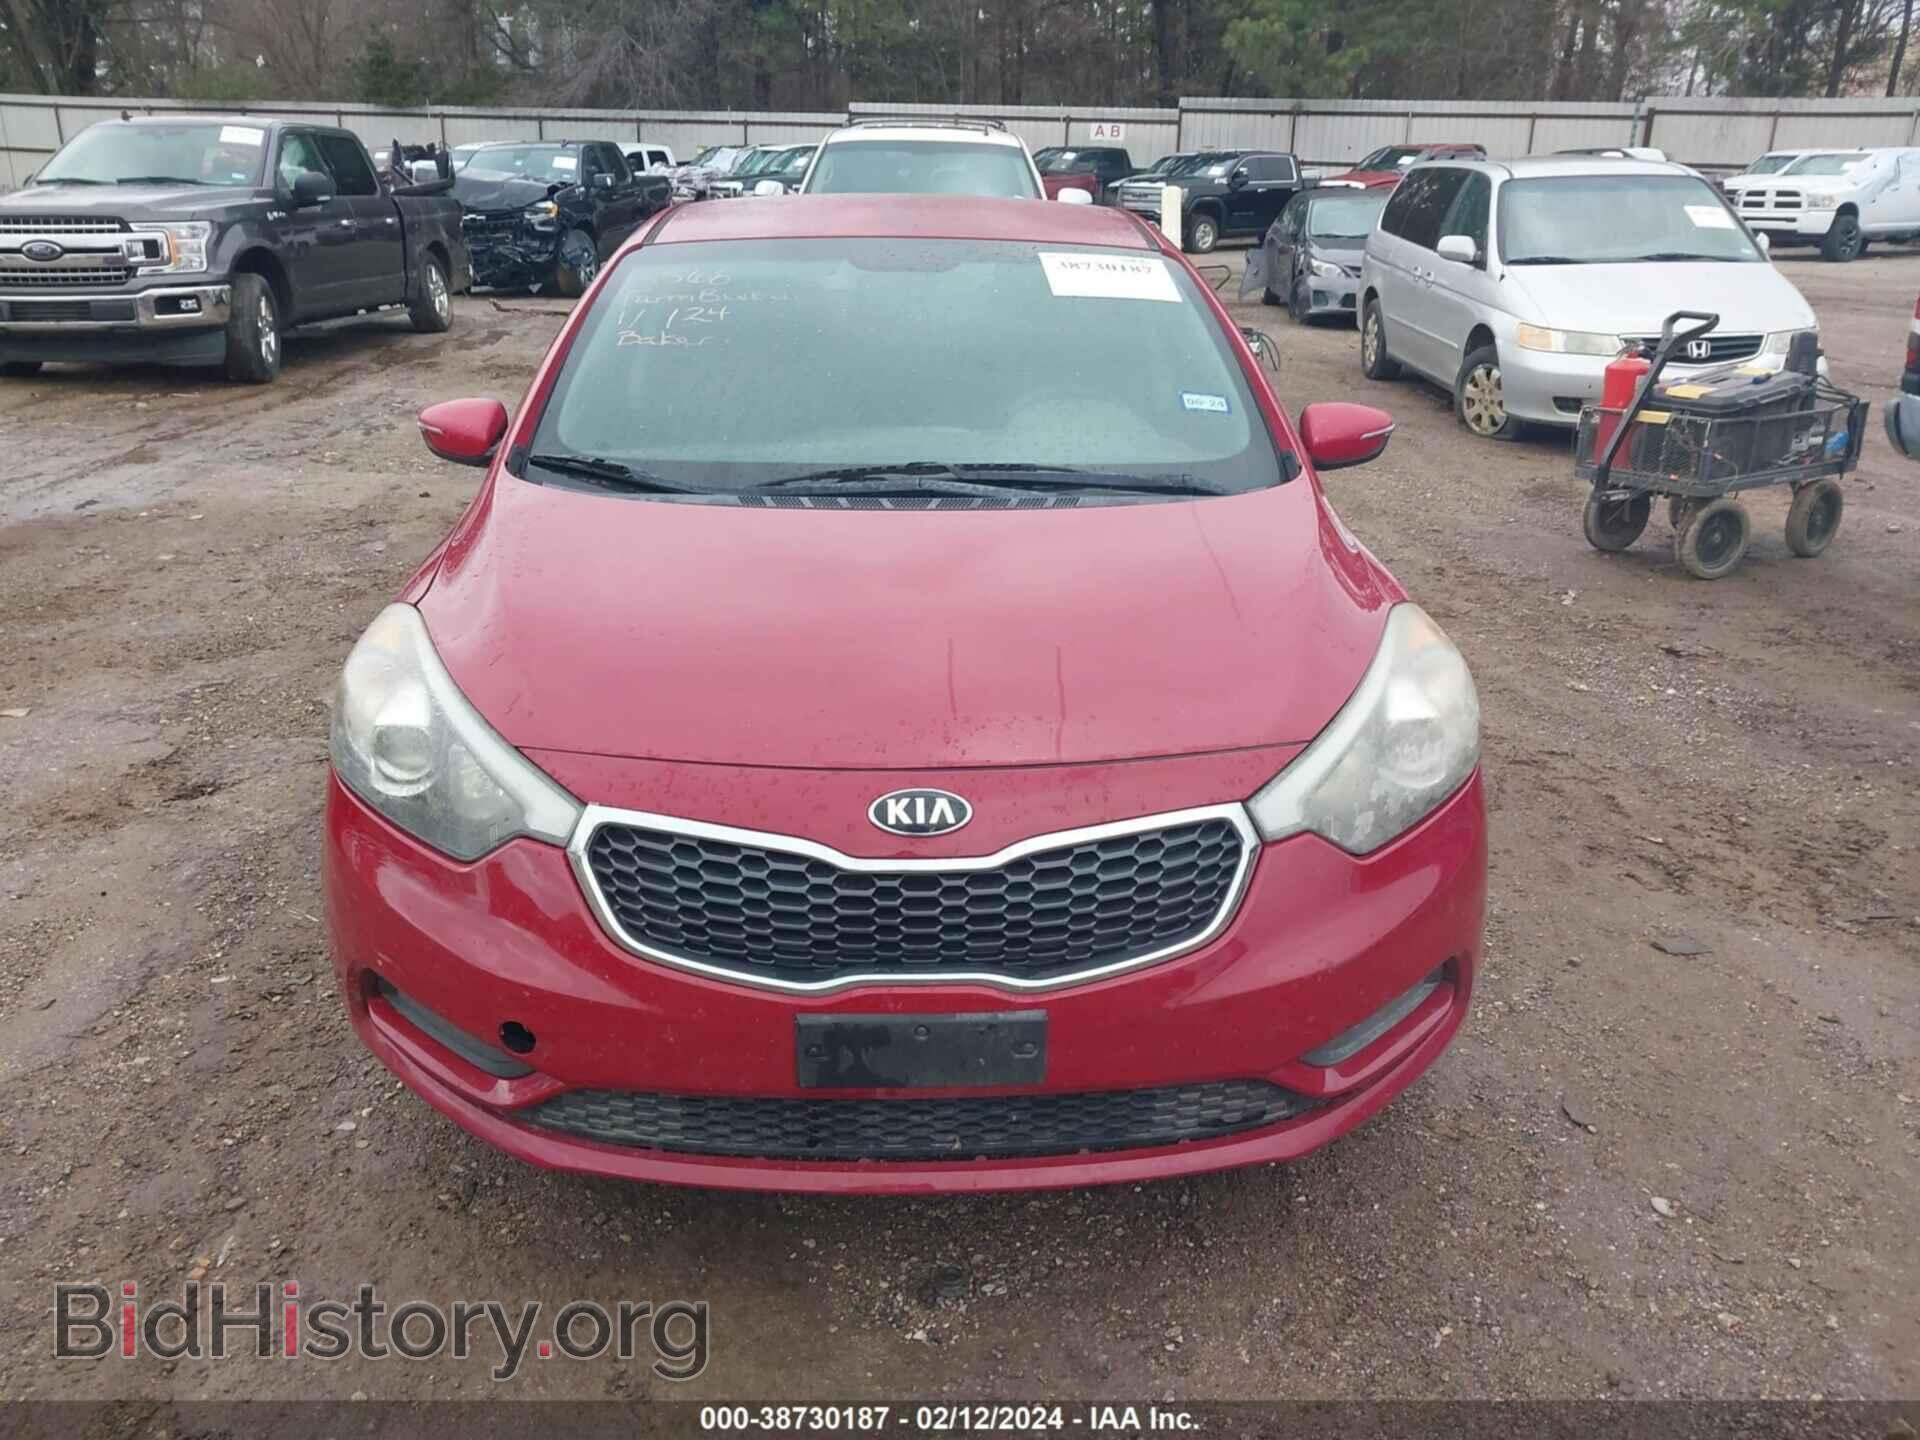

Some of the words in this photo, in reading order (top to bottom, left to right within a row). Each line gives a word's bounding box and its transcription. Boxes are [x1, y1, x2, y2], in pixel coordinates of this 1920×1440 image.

[1094, 124, 1105, 137] A
[1110, 124, 1121, 137] B
[886, 797, 956, 825] KIA
